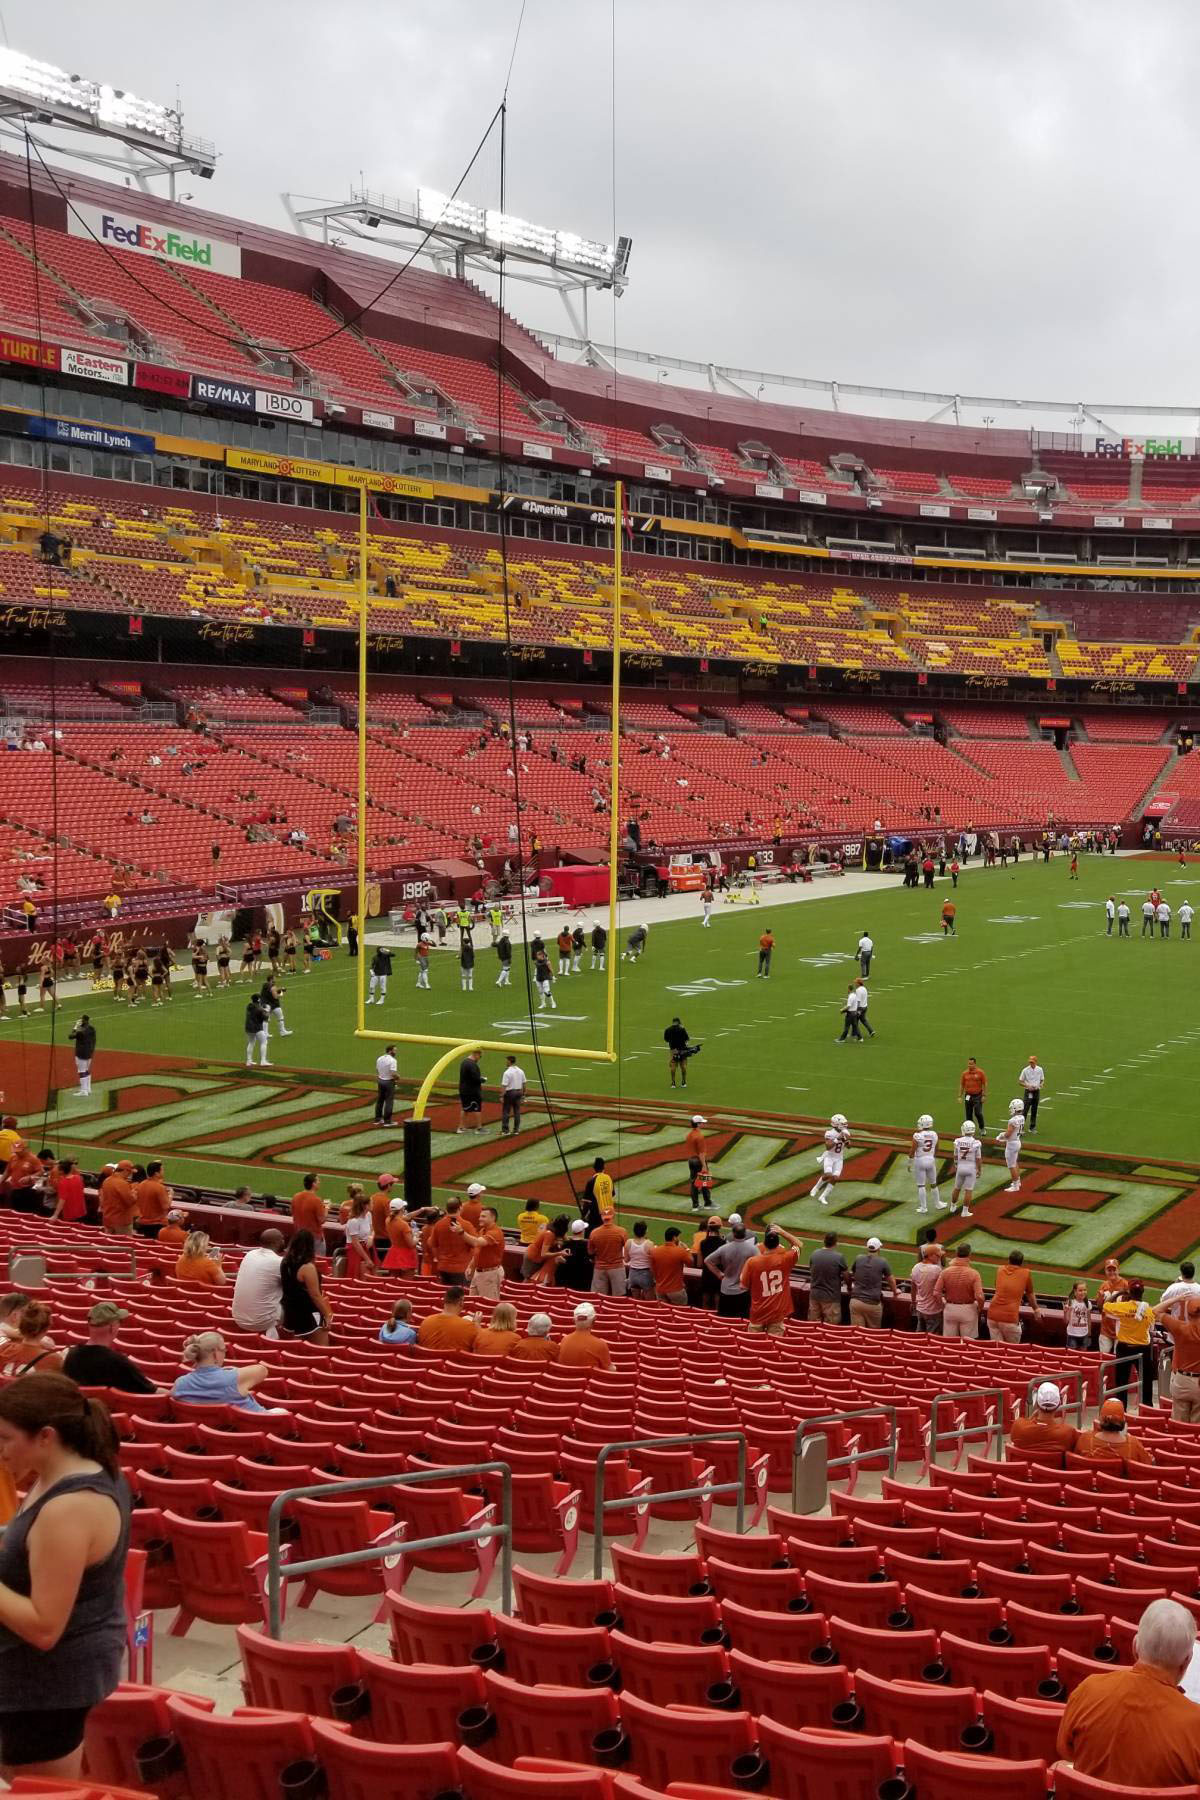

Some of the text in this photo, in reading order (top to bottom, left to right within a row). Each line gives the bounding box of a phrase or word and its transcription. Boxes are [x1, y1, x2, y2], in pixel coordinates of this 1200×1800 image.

[102, 214, 211, 265] FedExField
[2, 341, 56, 367] TURTLE
[77, 352, 123, 374] Eastern
[68, 364, 110, 381] Motors...
[198, 381, 252, 406] RE/MAX
[270, 394, 303, 412] BDO
[70, 427, 131, 449] Merrill Lynch
[1096, 438, 1181, 455] FedExField
[240, 457, 321, 478] MARYLAND LOTTERY
[348, 475, 422, 493] MARYLAND LOTTERY
[529, 502, 567, 516] Ameritel
[402, 880, 430, 900] 1982
[835, 1142, 843, 1154] 8
[923, 1140, 932, 1152] 3
[960, 1147, 970, 1160] 7
[760, 1270, 783, 1298] 12
